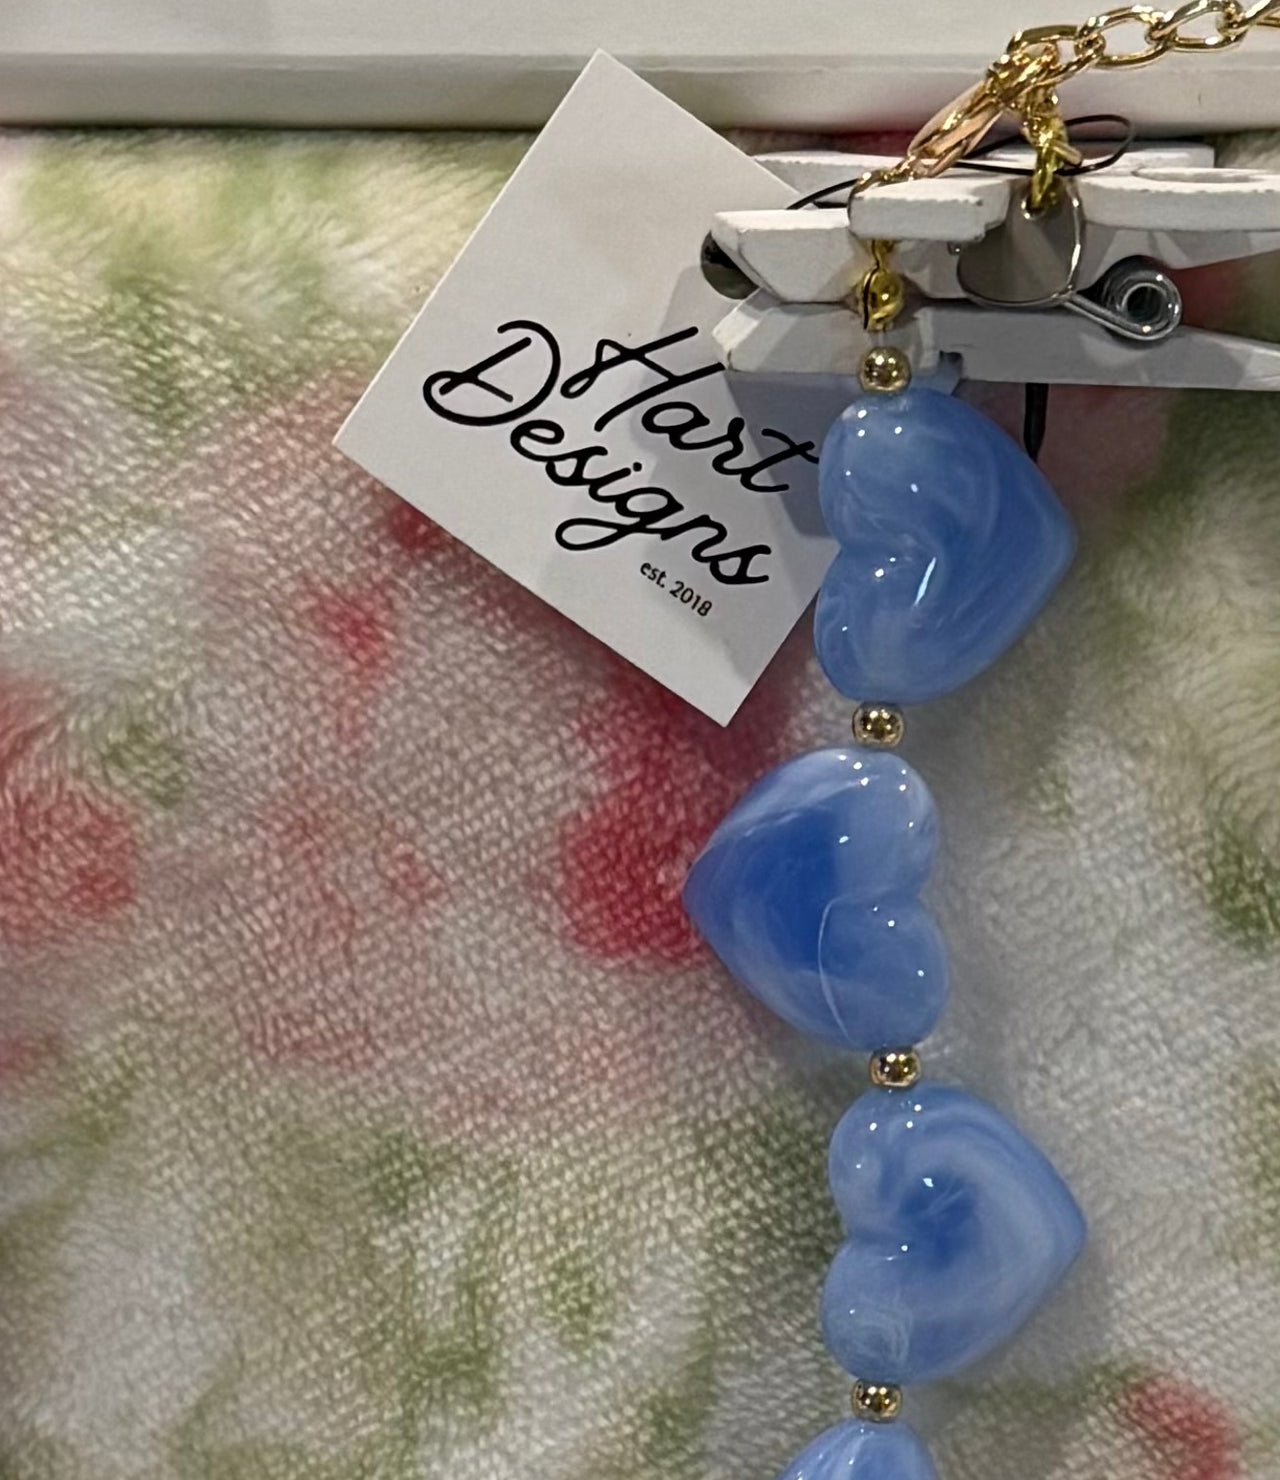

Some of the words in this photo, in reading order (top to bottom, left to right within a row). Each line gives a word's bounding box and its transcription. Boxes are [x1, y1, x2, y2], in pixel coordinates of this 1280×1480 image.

[423, 320, 771, 585] Designs
[560, 326, 820, 492] Hart
[639, 562, 667, 589] est.
[668, 580, 713, 617] 2018
